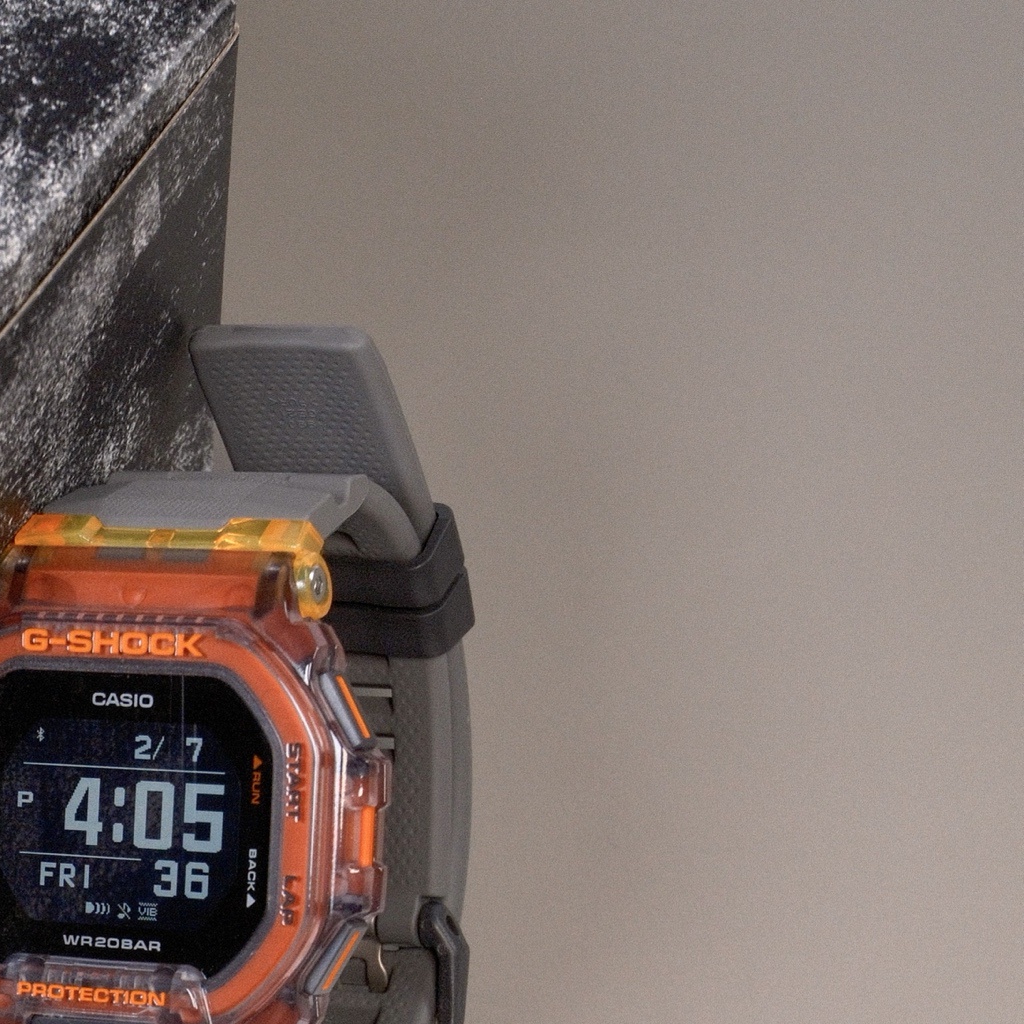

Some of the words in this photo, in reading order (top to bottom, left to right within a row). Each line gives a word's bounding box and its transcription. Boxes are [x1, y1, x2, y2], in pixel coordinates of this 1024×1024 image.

[22, 627, 204, 657] G-SHOCK
[92, 692, 154, 708] CASIO
[186, 737, 203, 762] 7
[251, 771, 262, 805] RUN
[286, 742, 302, 823] START
[17, 791, 33, 807] P
[64, 777, 225, 853] 4:05
[39, 861, 90, 889] FRI
[153, 859, 210, 900] 36
[247, 849, 257, 891] BACK
[280, 875, 297, 926] LAP
[63, 934, 161, 952] WR20BAR
[16, 981, 166, 1006] PROTECTION
